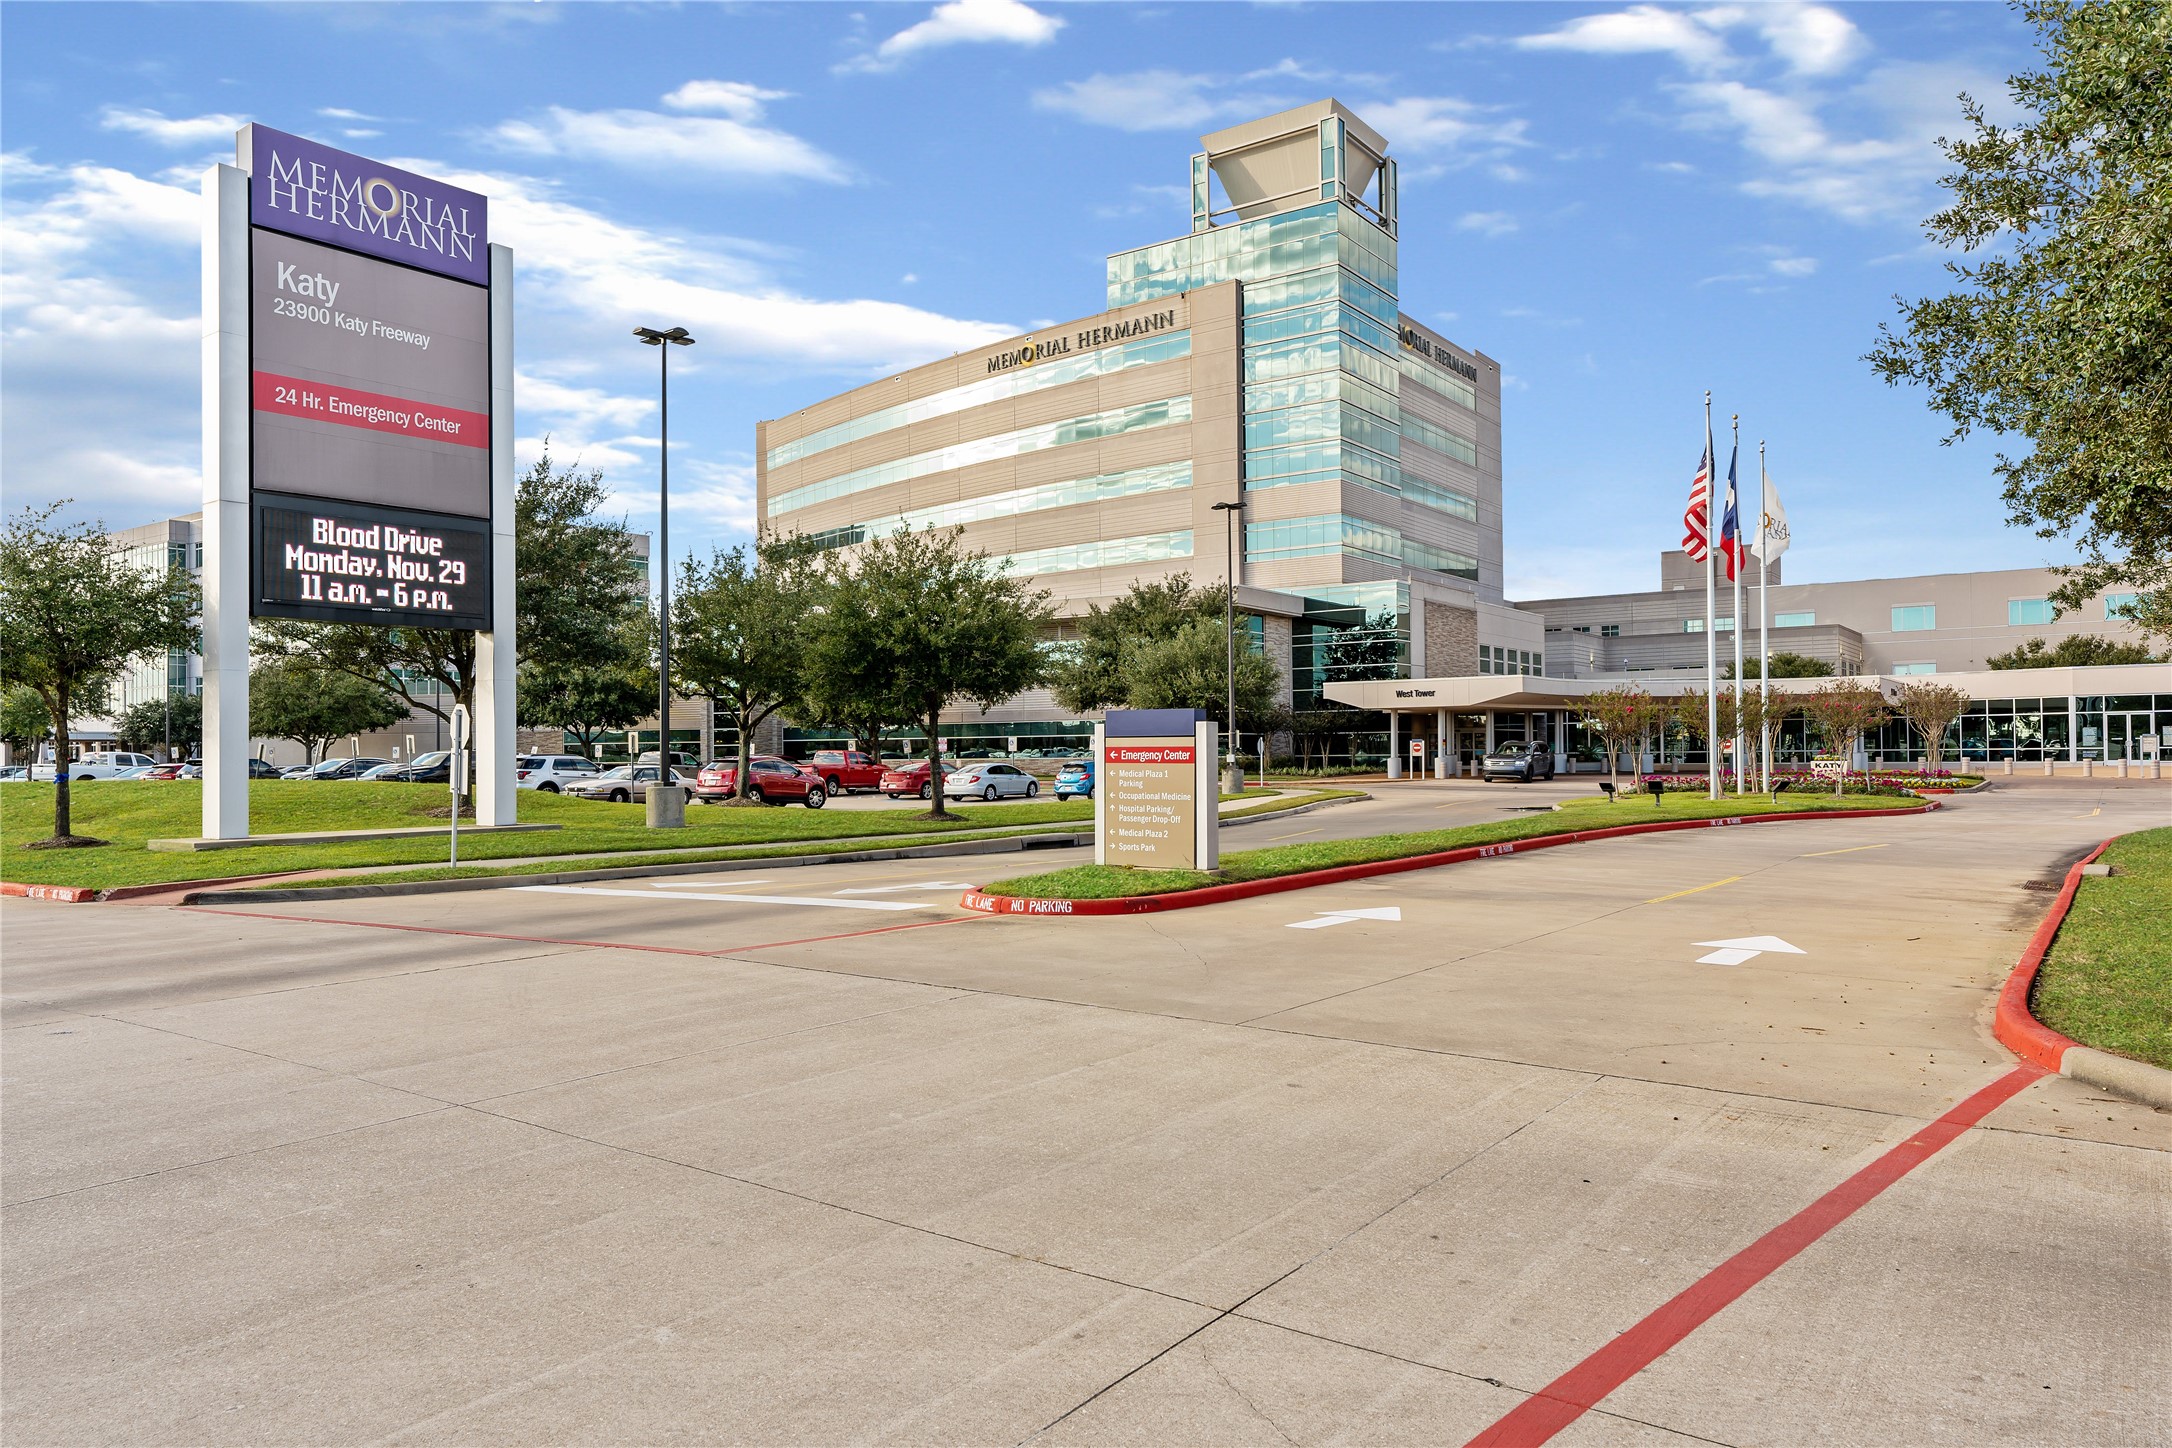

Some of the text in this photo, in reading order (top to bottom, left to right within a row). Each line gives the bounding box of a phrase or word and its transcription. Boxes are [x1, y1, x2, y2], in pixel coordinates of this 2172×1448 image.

[268, 150, 477, 239] MEMORIAL
[268, 175, 476, 263] HERMANN
[277, 261, 340, 307] Katy
[273, 297, 430, 350] 23900 Katy Freeway
[987, 310, 1175, 373] MEMORIAL HERMANN
[1434, 345, 1477, 383] HERMANN
[275, 386, 461, 435] 24 Hr. Emergency Center
[312, 517, 443, 557] Blood Drive
[285, 544, 466, 585] Monday, Nov. 29
[301, 574, 453, 611] 11 a.m. - 6 p.m.
[1395, 689, 1436, 698] West Tower
[1121, 750, 1190, 762] Emergency Center
[1119, 770, 1168, 778] Medical Plaza 1
[1119, 780, 1143, 789] Parking
[1119, 792, 1191, 801] Occupational Medicine
[1119, 805, 1175, 815] Hospital Parking/
[1119, 814, 1181, 824] Passenger Drop-Off
[1119, 829, 1168, 838] Medical Plaza 2
[1119, 843, 1156, 852] Sports Park
[976, 897, 995, 910] LANE
[1011, 900, 1024, 912] NO
[1029, 901, 1072, 913] PARKING
